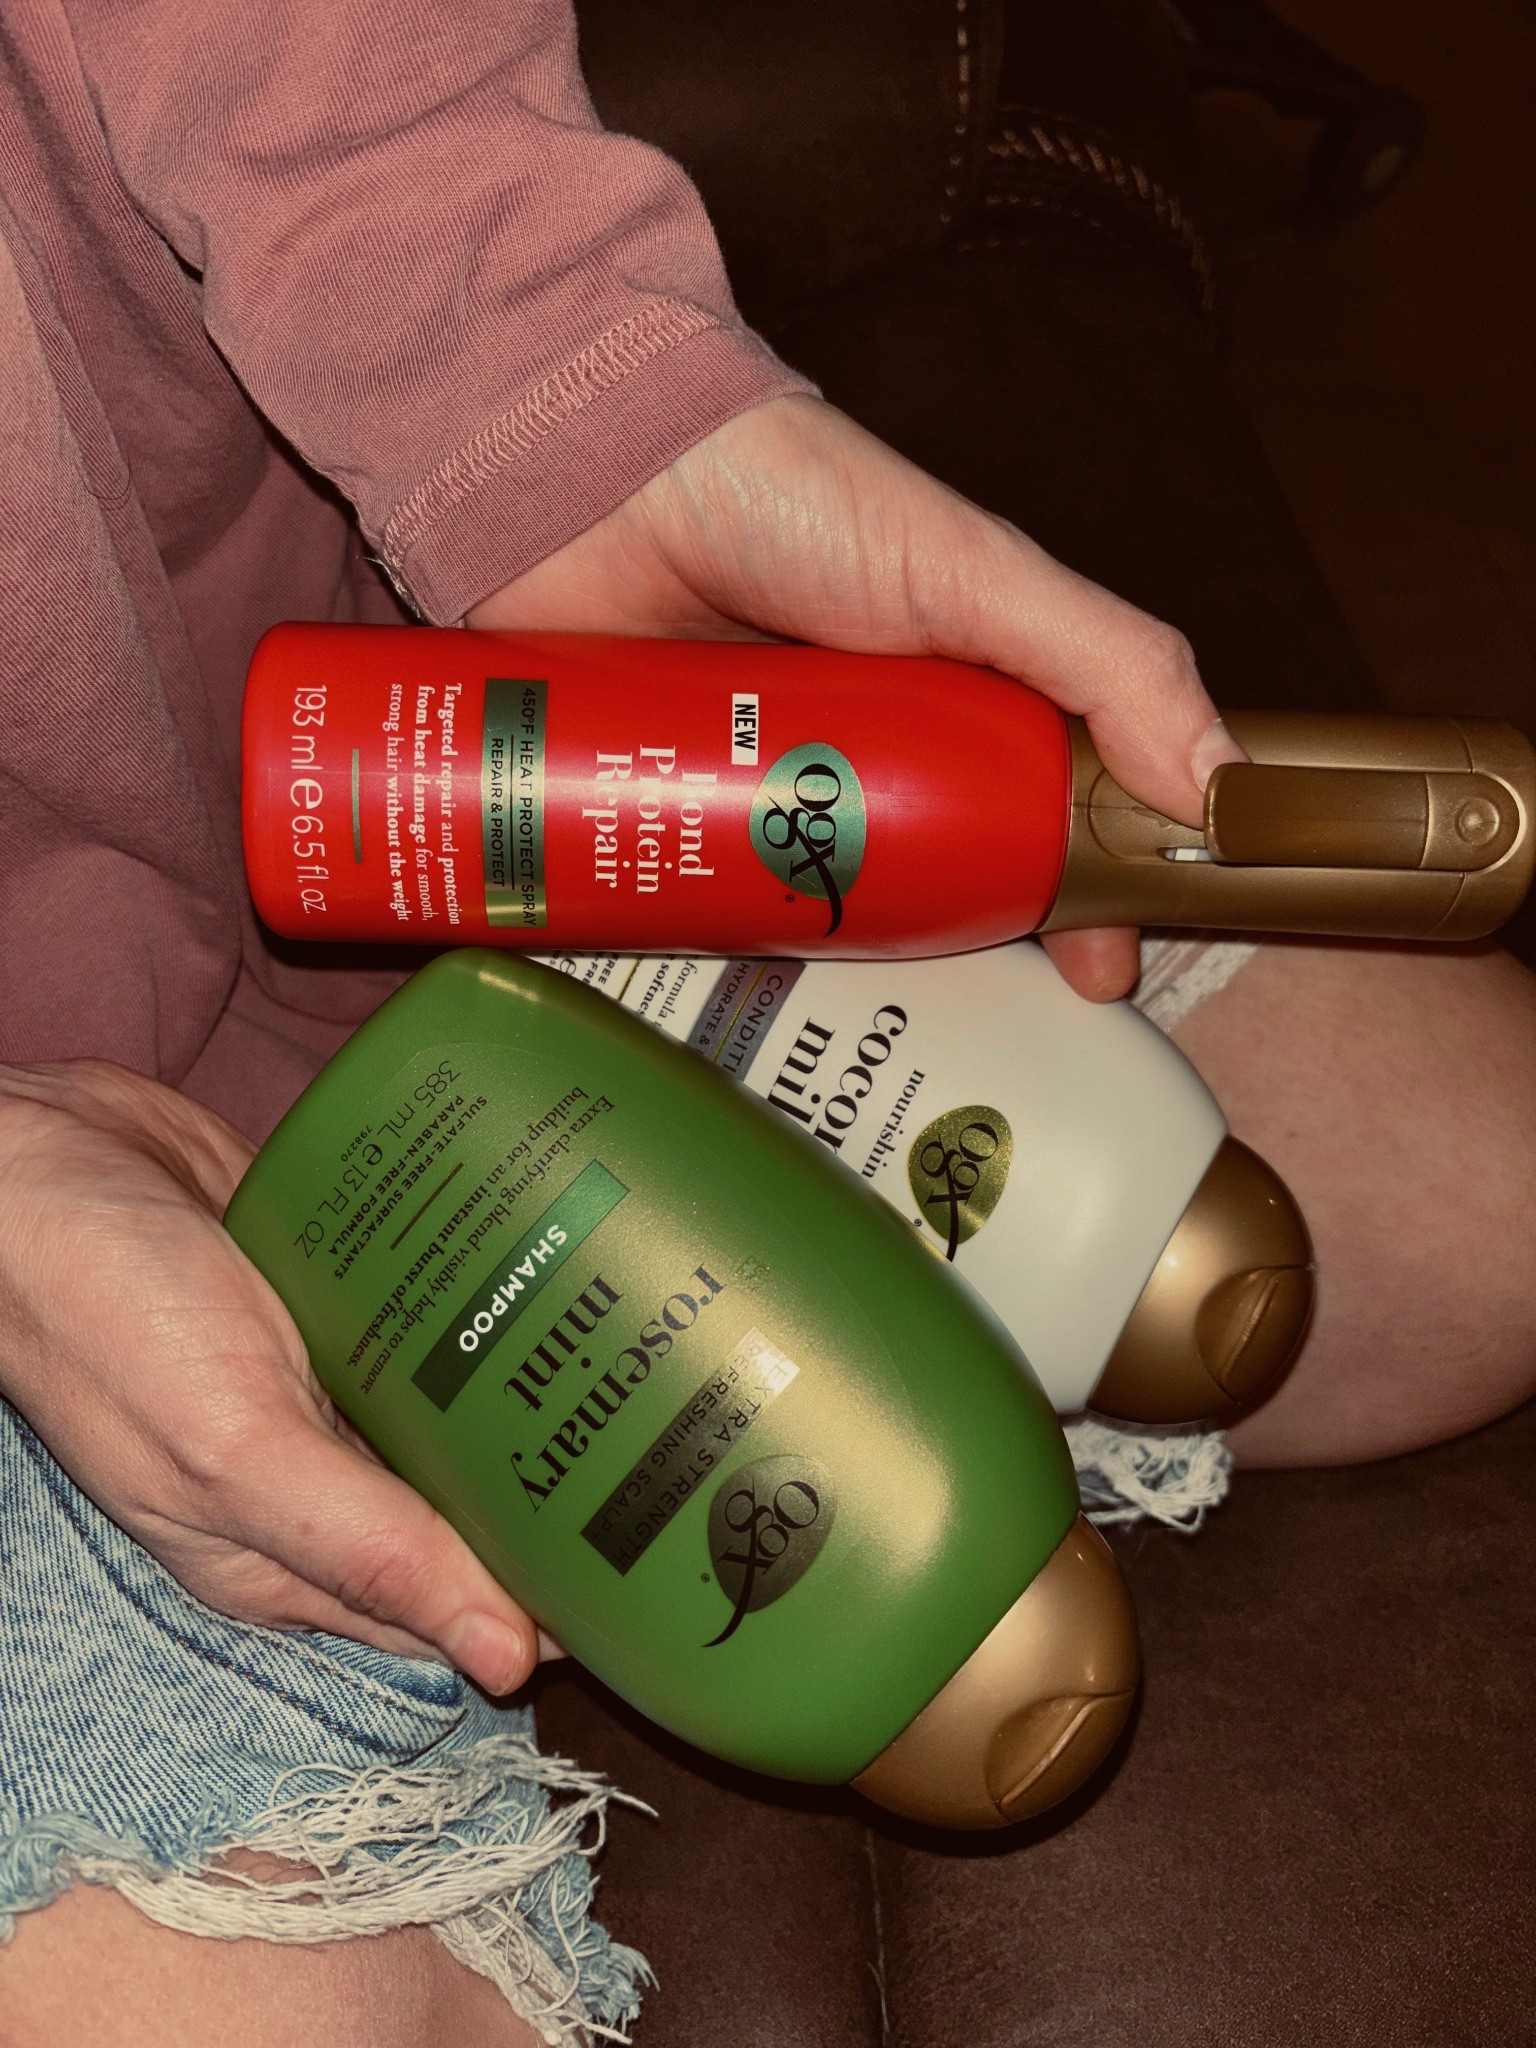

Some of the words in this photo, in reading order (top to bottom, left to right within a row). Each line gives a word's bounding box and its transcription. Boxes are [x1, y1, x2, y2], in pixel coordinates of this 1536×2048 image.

[293, 684, 327, 727] 193
[382, 683, 402, 732] strong
[416, 685, 435, 724] from
[438, 683, 462, 756] Targeted
[521, 688, 535, 734] 450°F
[734, 703, 757, 750] NEW
[291, 735, 323, 770] ml
[387, 736, 405, 771] hair
[414, 728, 432, 768] heat
[491, 738, 503, 798] REPAIR
[520, 740, 534, 790] HEAT
[387, 775, 404, 847] without
[409, 772, 431, 843] damage
[436, 762, 456, 817] repair
[491, 804, 503, 814] &
[291, 816, 325, 858] 6.5
[441, 822, 459, 852] and
[519, 797, 534, 880] PROTECT
[582, 750, 633, 889] Repair
[389, 852, 406, 877] the
[416, 848, 433, 870] for
[491, 818, 505, 887] PROTECT
[390, 880, 413, 920] weight
[418, 874, 439, 920] smooth,
[437, 857, 462, 924] protection
[521, 885, 536, 926] SPRAY
[637, 963, 670, 1016] softnes
[658, 961, 698, 1019] formula
[707, 962, 750, 1033] HYDRATE
[698, 1034, 709, 1045] &
[722, 975, 783, 1073] CONDITI
[414, 1060, 461, 1108] 385
[768, 1017, 835, 1124] mil
[377, 1102, 415, 1139] mL
[527, 1086, 589, 1141] buildup
[569, 1095, 615, 1134] Extra
[861, 1068, 926, 1179] nourishin
[341, 1125, 373, 1162] 798270
[375, 1095, 464, 1194] PARABEN-FREE
[402, 1096, 487, 1190] SULFATE-FREE
[506, 1141, 532, 1166] for
[343, 1164, 369, 1192] 13
[486, 1164, 506, 1185] an
[500, 1133, 571, 1205] clarifying
[317, 1187, 349, 1216] FL
[329, 1194, 378, 1255] FORMULA
[438, 1184, 492, 1243] instant
[294, 1221, 325, 1259] OZ
[335, 1189, 404, 1280] SURFACTANTS
[467, 1203, 512, 1251] blend
[404, 1242, 445, 1286] burst
[427, 1248, 470, 1296] visibly
[459, 1224, 567, 1352] SHAMPOO
[390, 1284, 406, 1310] of
[401, 1294, 436, 1333] helps
[347, 1300, 397, 1366] freshness.
[389, 1332, 404, 1349] to
[503, 1272, 625, 1413] mint
[361, 1348, 391, 1394] remove
[510, 1262, 727, 1513] rosemary
[651, 1340, 762, 1467] REFRESHING
[713, 1364, 788, 1443] EXTRA
[613, 1448, 714, 1567] STRENGTH
